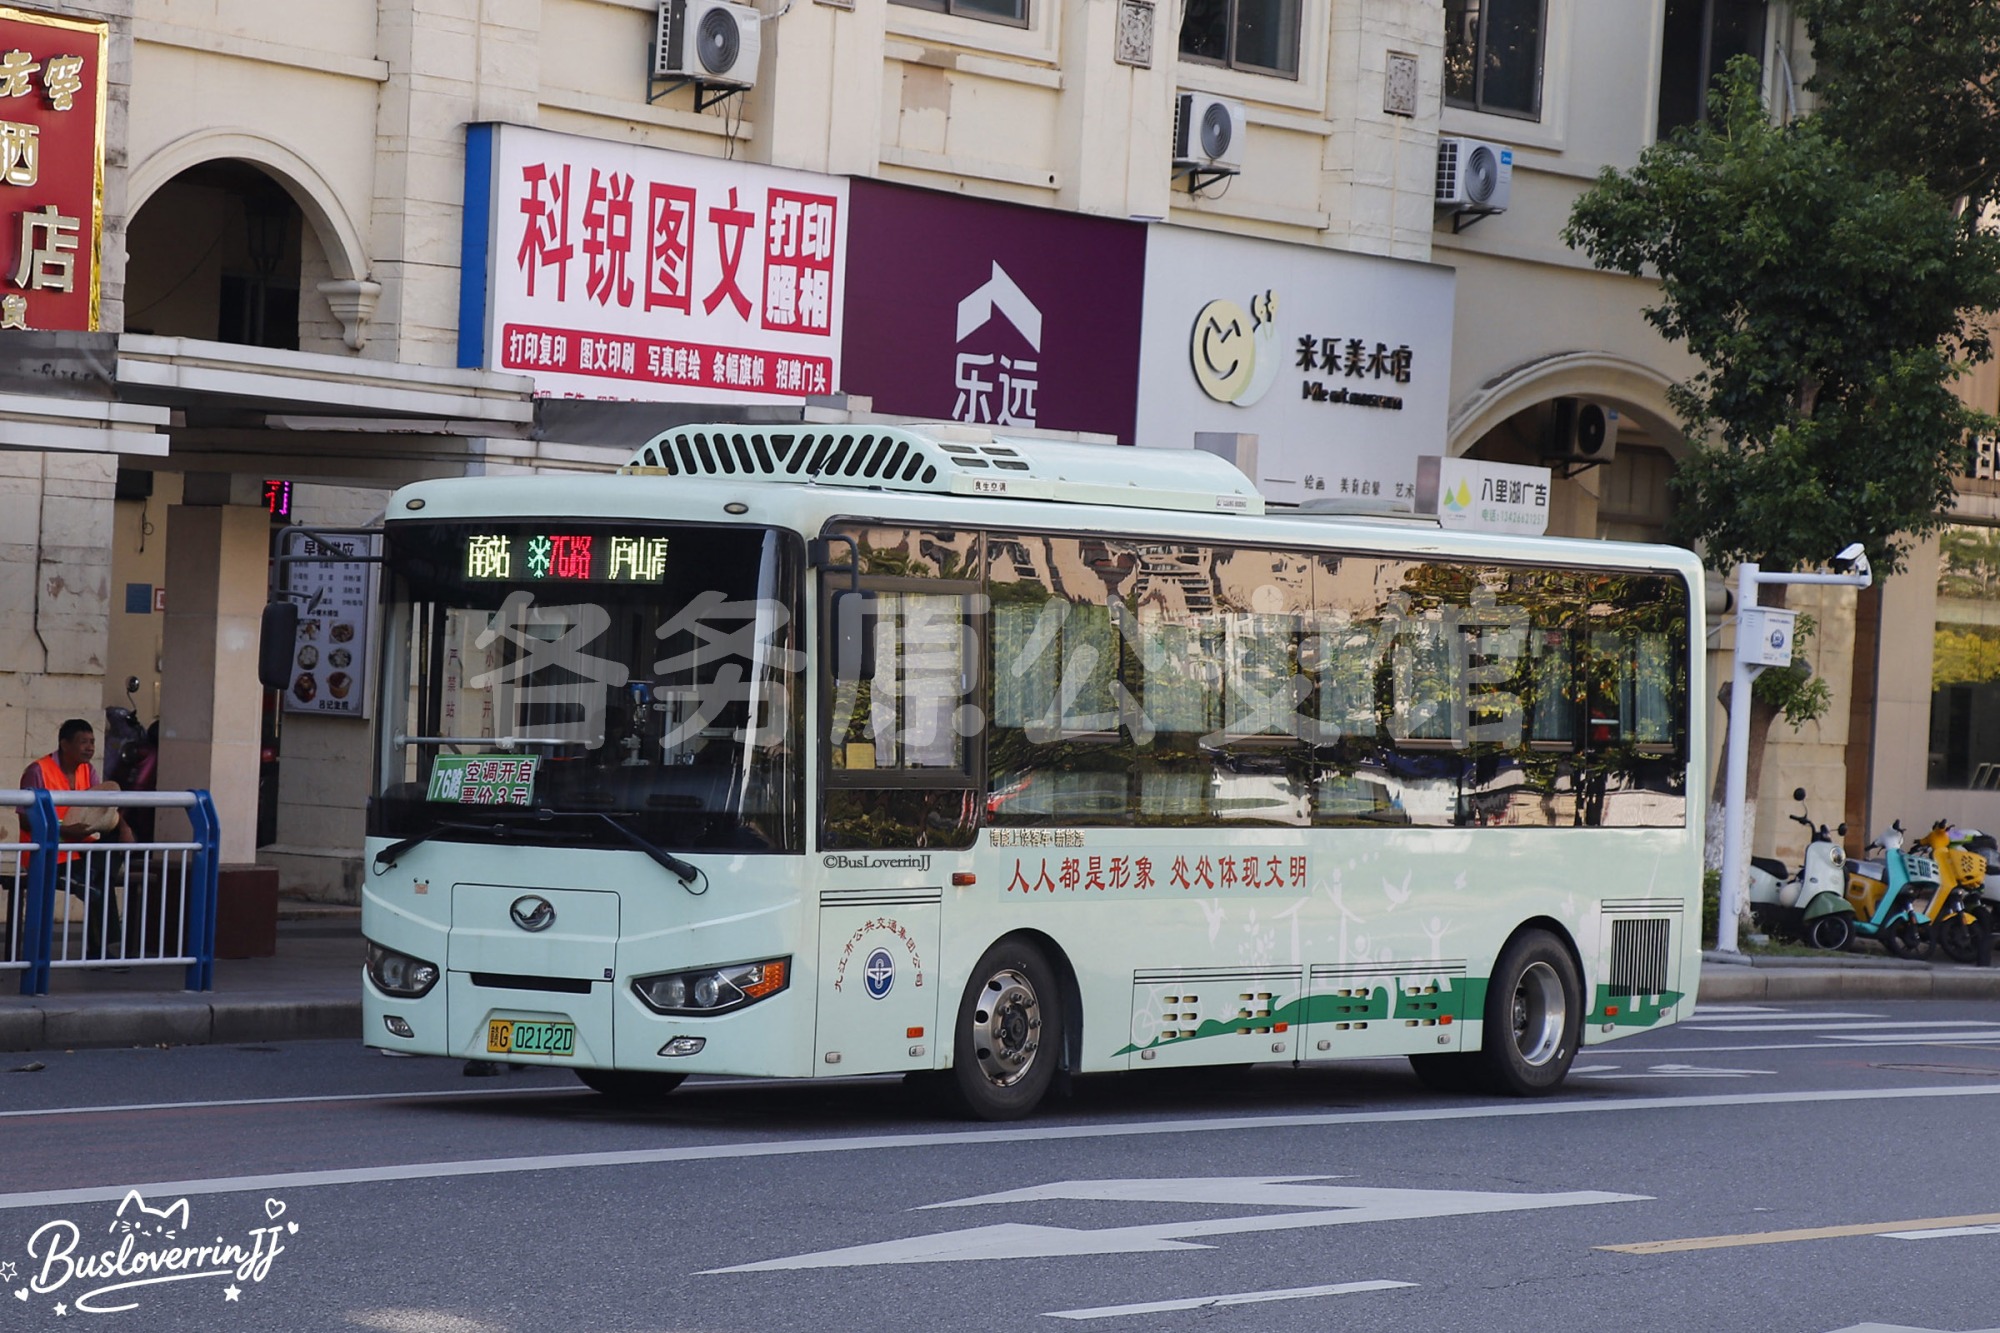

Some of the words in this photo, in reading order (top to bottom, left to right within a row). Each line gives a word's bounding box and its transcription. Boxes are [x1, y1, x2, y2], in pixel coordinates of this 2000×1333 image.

[517, 162, 755, 322] 科锐图文
[769, 197, 834, 261] 打印
[764, 263, 831, 329] 照相
[509, 329, 567, 367] 打印复印
[579, 337, 636, 375] 图文印刷
[647, 344, 701, 381] 写真喷绘
[712, 351, 765, 387] 条幅旗帜
[775, 357, 827, 393] 招牌门头
[1295, 333, 1413, 383] 米乐美术馆
[952, 352, 1039, 428] 乐远
[1481, 477, 1547, 507] 八里湖广告
[549, 535, 592, 580] 76路
[458, 785, 529, 806] 票价3元
[464, 760, 534, 784] 空调开启
[1007, 855, 1155, 894] 人人都是形象
[1169, 854, 1308, 890] 处处体现文明
